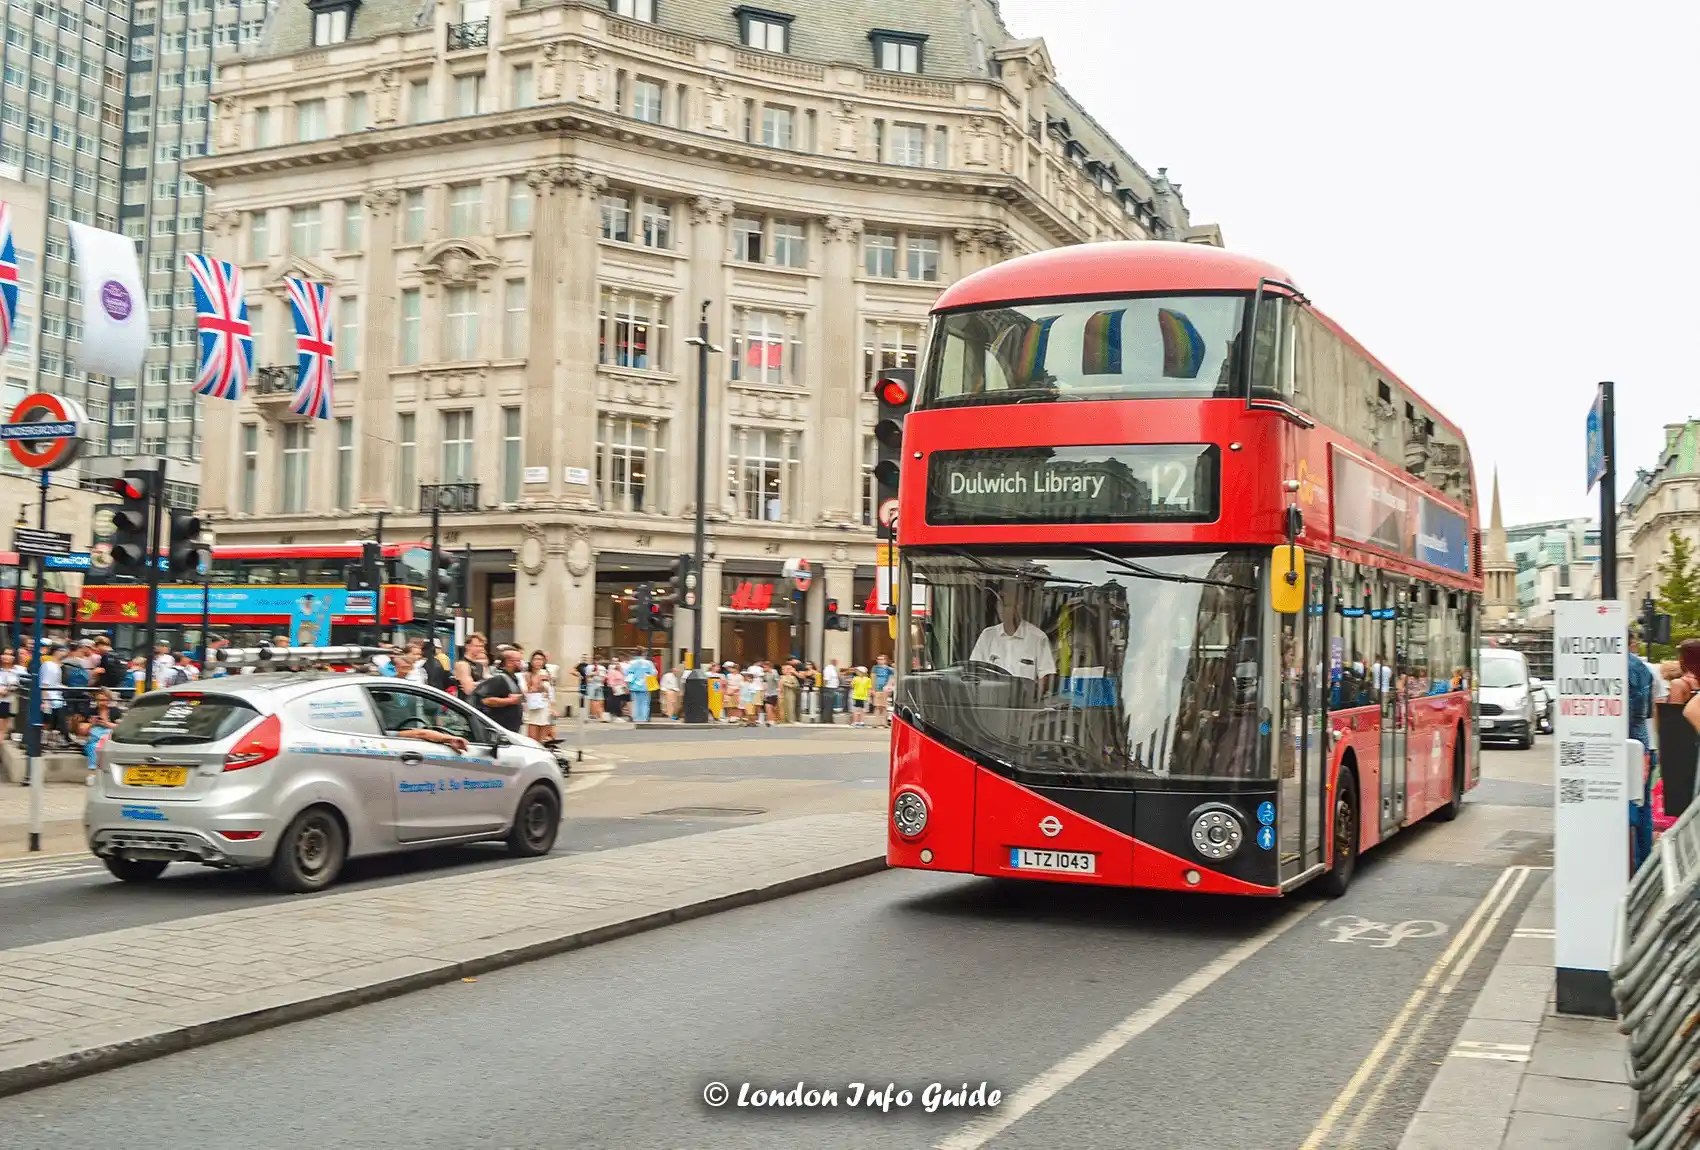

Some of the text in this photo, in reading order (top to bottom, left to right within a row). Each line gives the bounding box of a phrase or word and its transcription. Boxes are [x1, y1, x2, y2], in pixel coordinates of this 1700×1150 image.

[949, 470, 1105, 498] Dulwich Library
[1151, 461, 1190, 505] 12
[1559, 636, 1621, 654] WELCOME
[1582, 657, 1598, 674] TO
[1560, 677, 1622, 695] LONDON'S
[1560, 698, 1622, 716] WEST END
[1024, 851, 1089, 869] LTZ 1043
